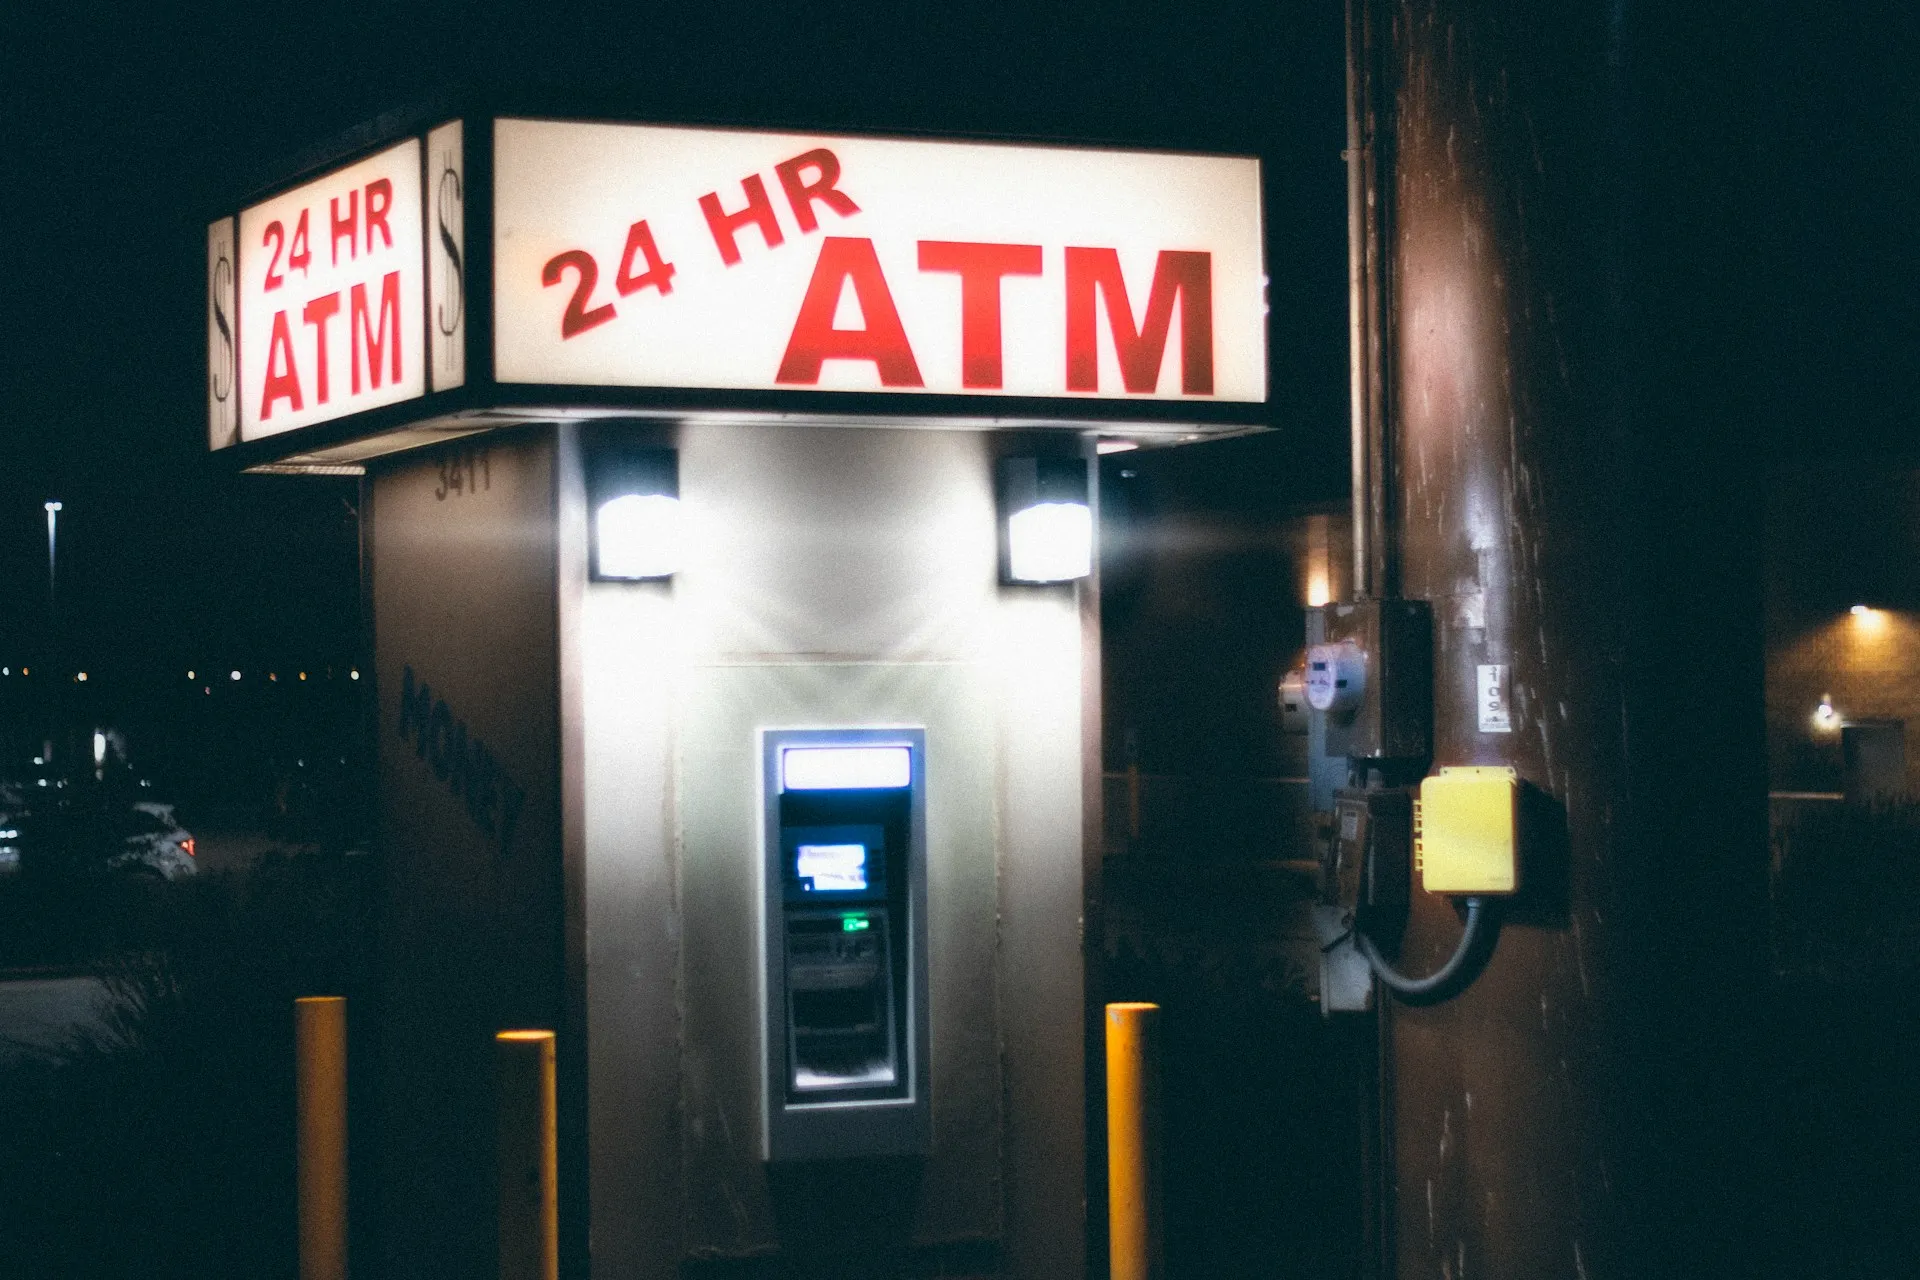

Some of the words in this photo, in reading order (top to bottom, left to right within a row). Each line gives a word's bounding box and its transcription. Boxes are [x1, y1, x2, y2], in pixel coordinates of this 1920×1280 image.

[263, 207, 312, 293] 24
[330, 177, 393, 268] HR
[541, 219, 676, 340] 24
[697, 147, 861, 268] HR
[260, 270, 402, 421] ATM
[774, 235, 1214, 396] ATM
